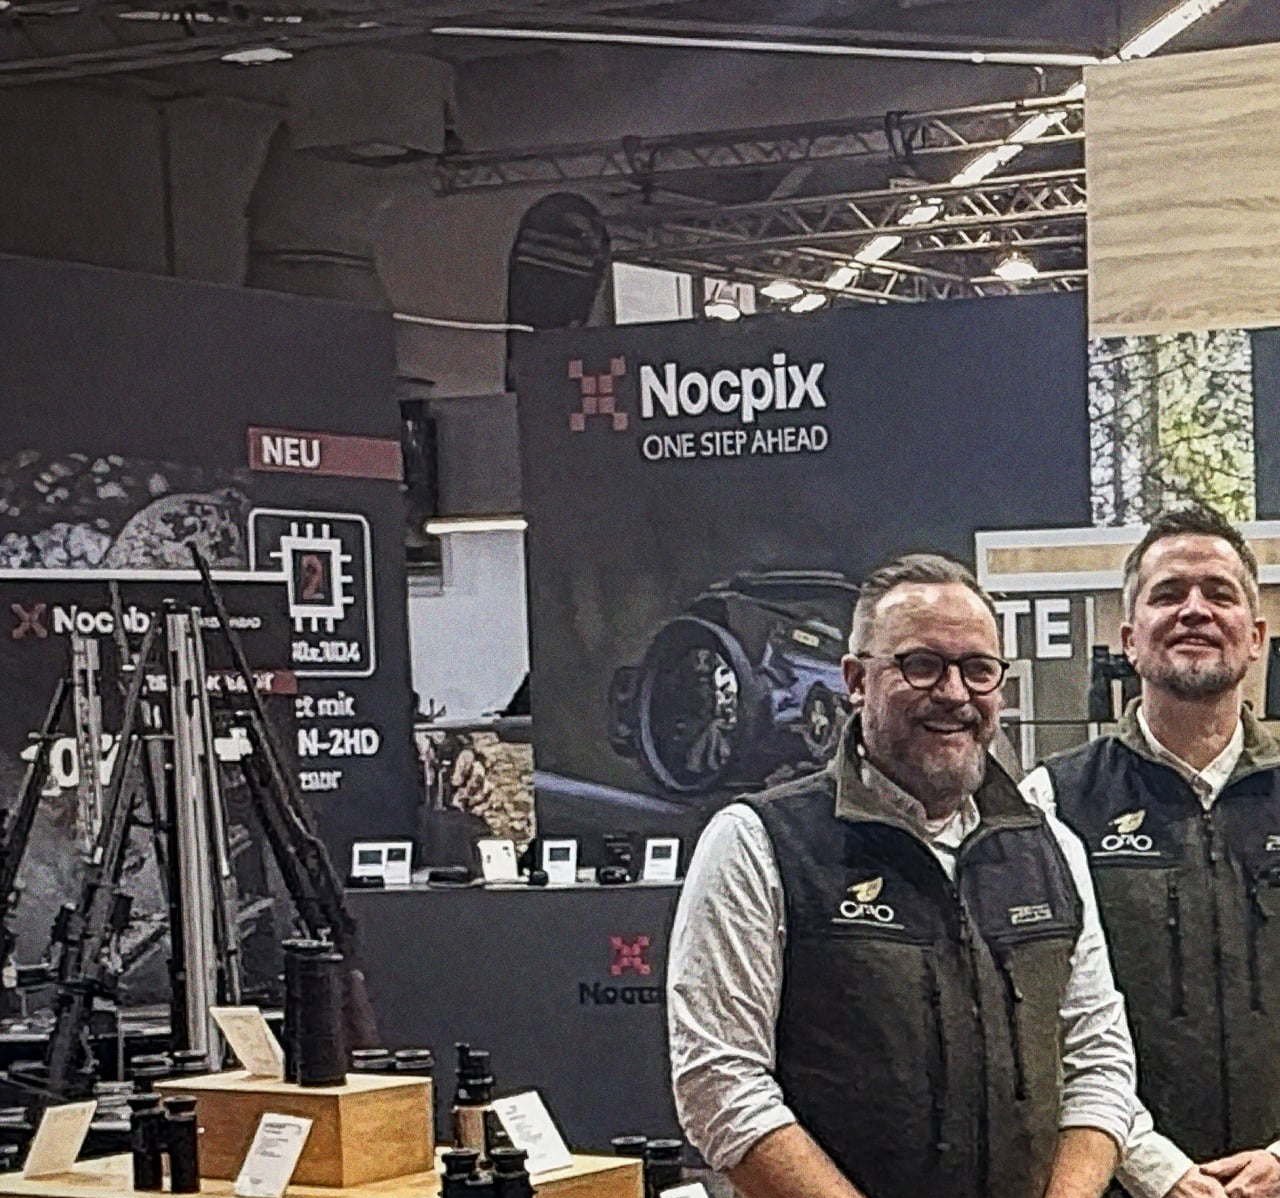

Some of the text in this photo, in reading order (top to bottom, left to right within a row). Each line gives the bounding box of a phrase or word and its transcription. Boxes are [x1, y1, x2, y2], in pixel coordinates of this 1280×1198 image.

[640, 353, 827, 423] Nocpix
[261, 435, 320, 468] NEU
[643, 425, 829, 460] ONE STEP AHEAD
